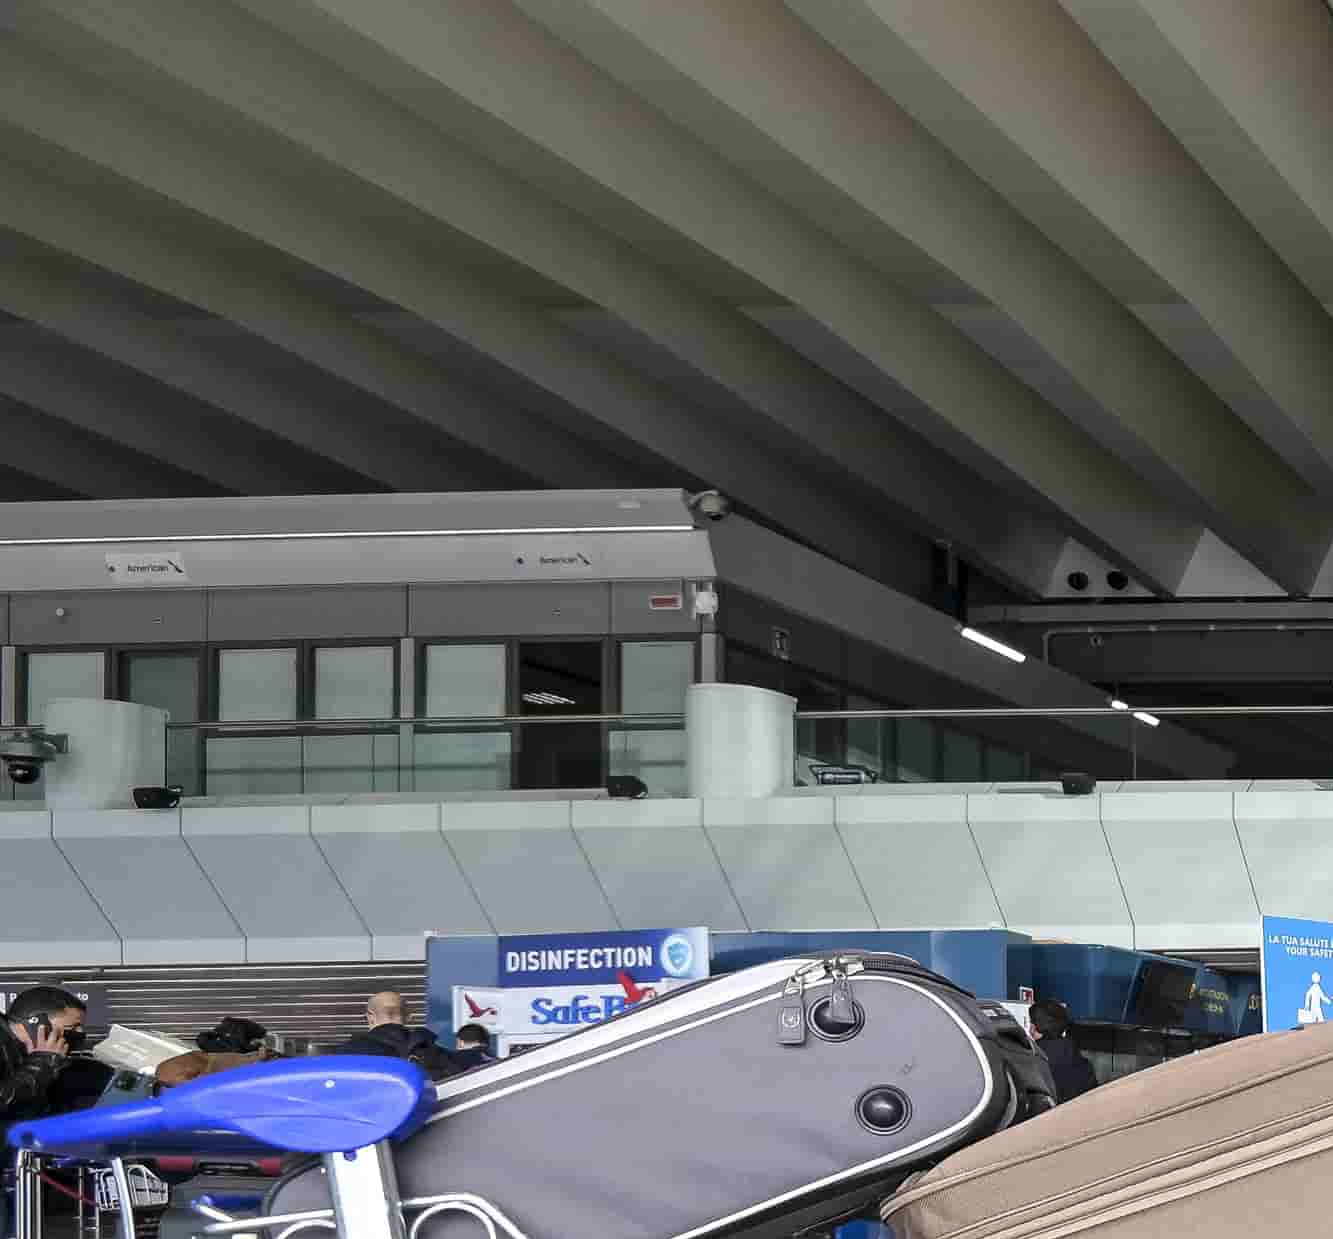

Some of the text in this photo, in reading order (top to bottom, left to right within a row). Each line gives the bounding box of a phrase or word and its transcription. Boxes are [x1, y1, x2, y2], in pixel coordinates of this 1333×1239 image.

[1268, 935, 1280, 945] LA
[1281, 935, 1298, 946] TUA
[1300, 937, 1328, 949] SALUTE
[1286, 946, 1309, 956] YOUR
[506, 946, 654, 972] DISINFECTION
[531, 994, 625, 1025] SafeB
